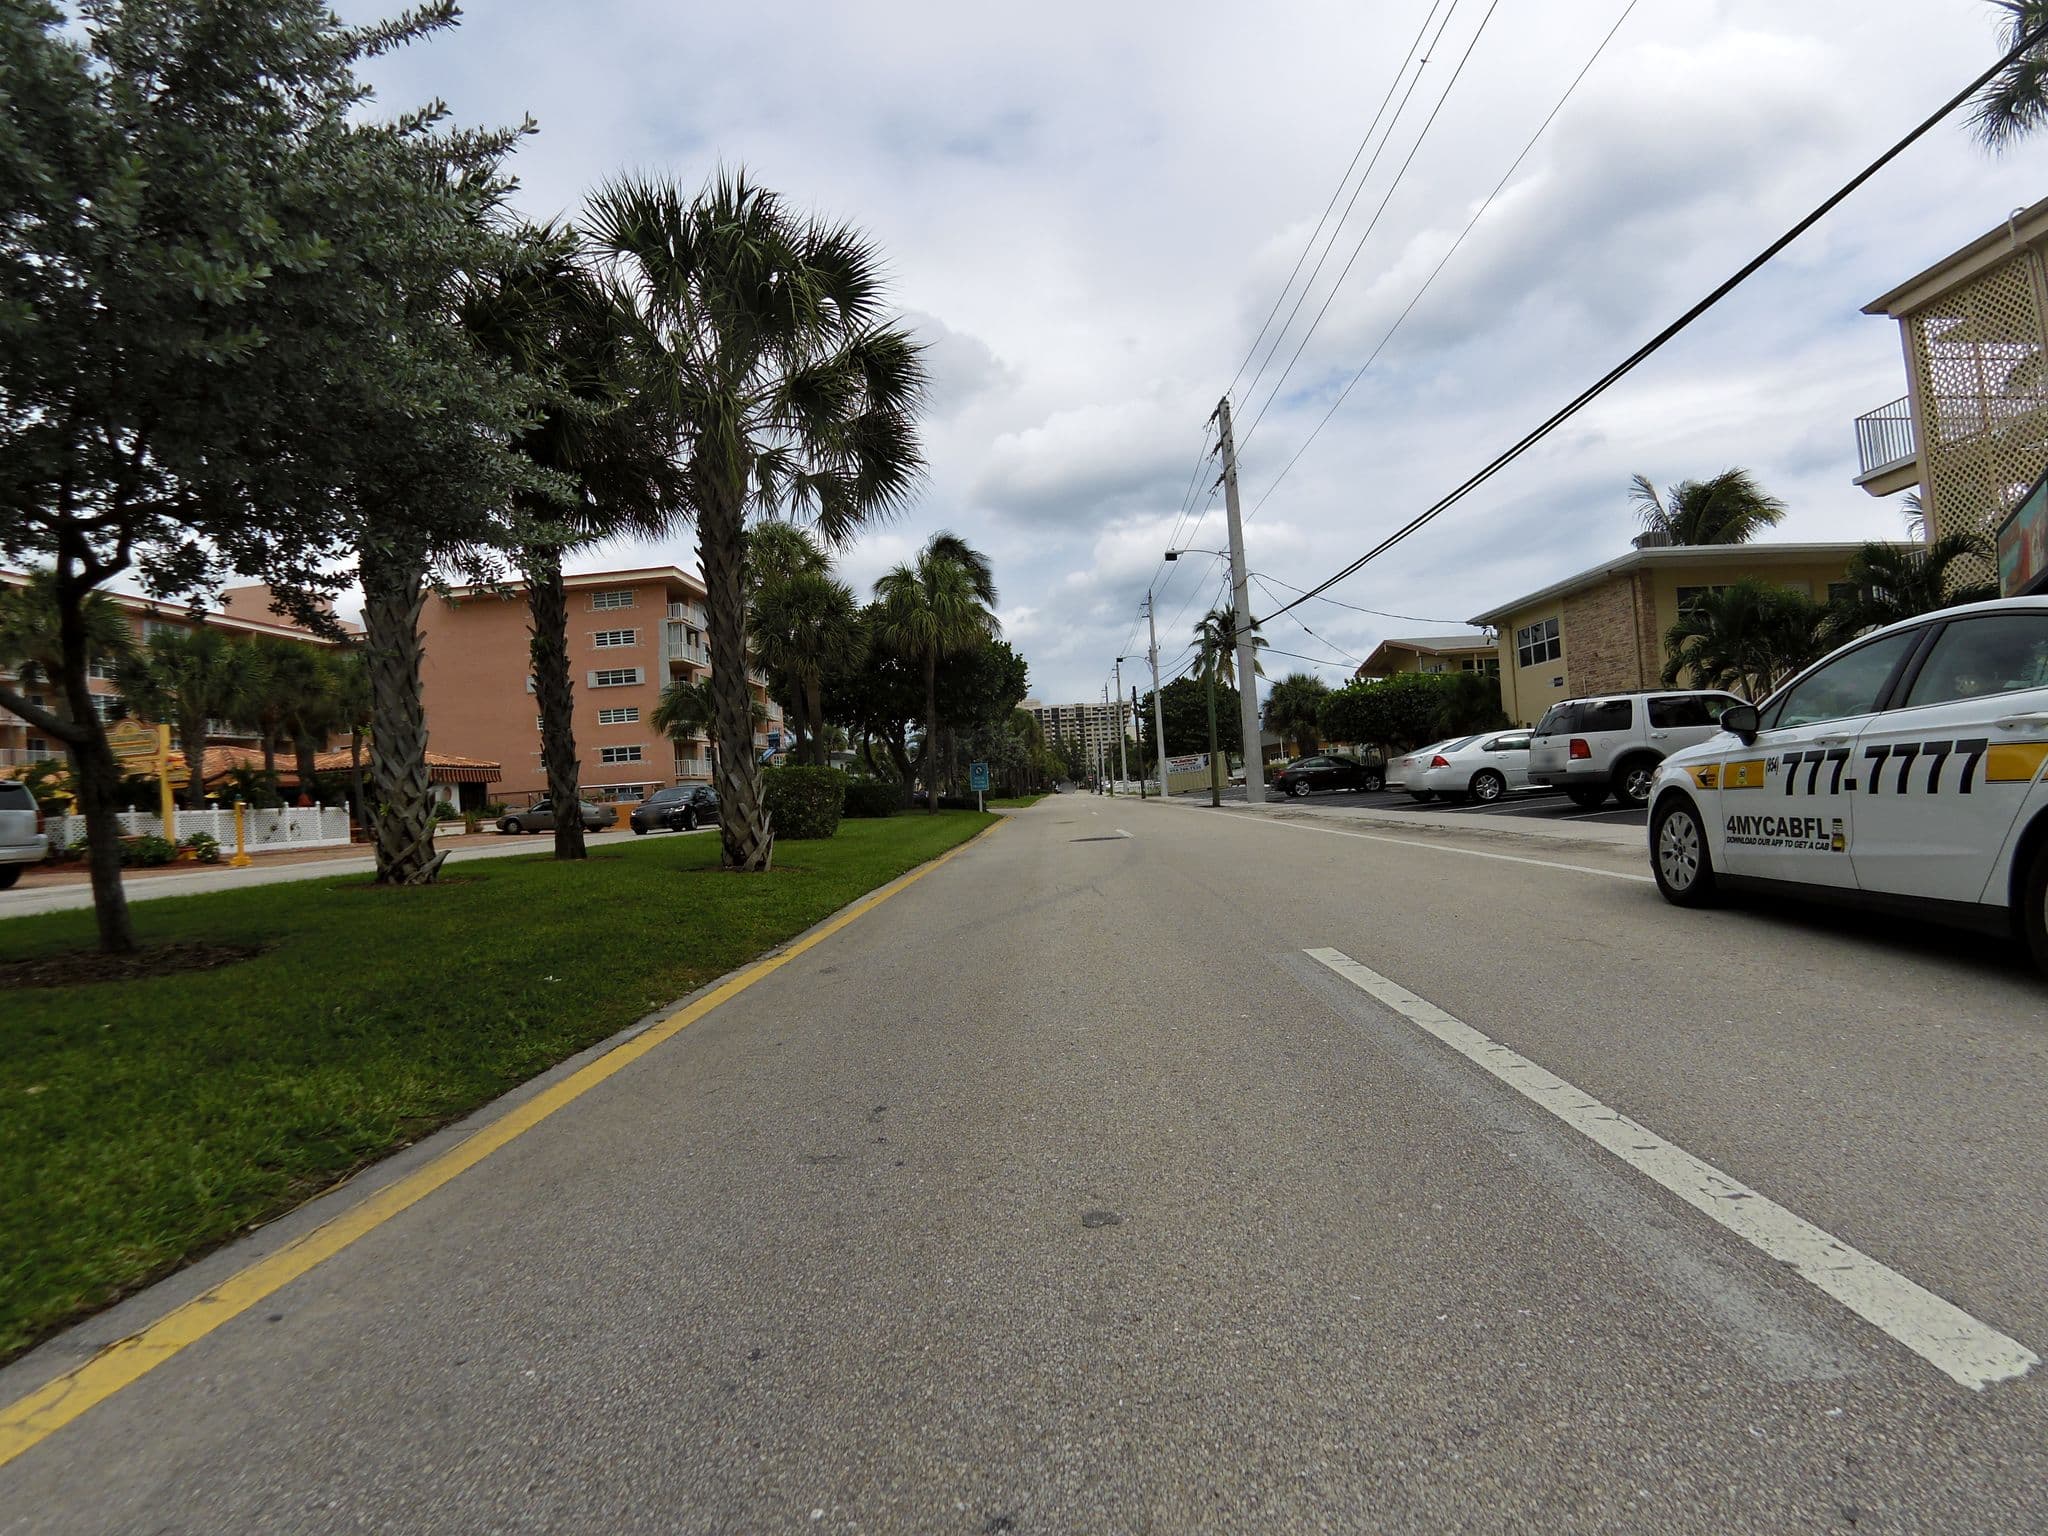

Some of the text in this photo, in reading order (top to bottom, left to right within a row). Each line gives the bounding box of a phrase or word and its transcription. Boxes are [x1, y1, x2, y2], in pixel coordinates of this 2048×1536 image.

[1726, 815, 1830, 840] 4MYCABFL
[1726, 836, 1830, 851] DOWNLOAD OUR APP TO GET A CAB
